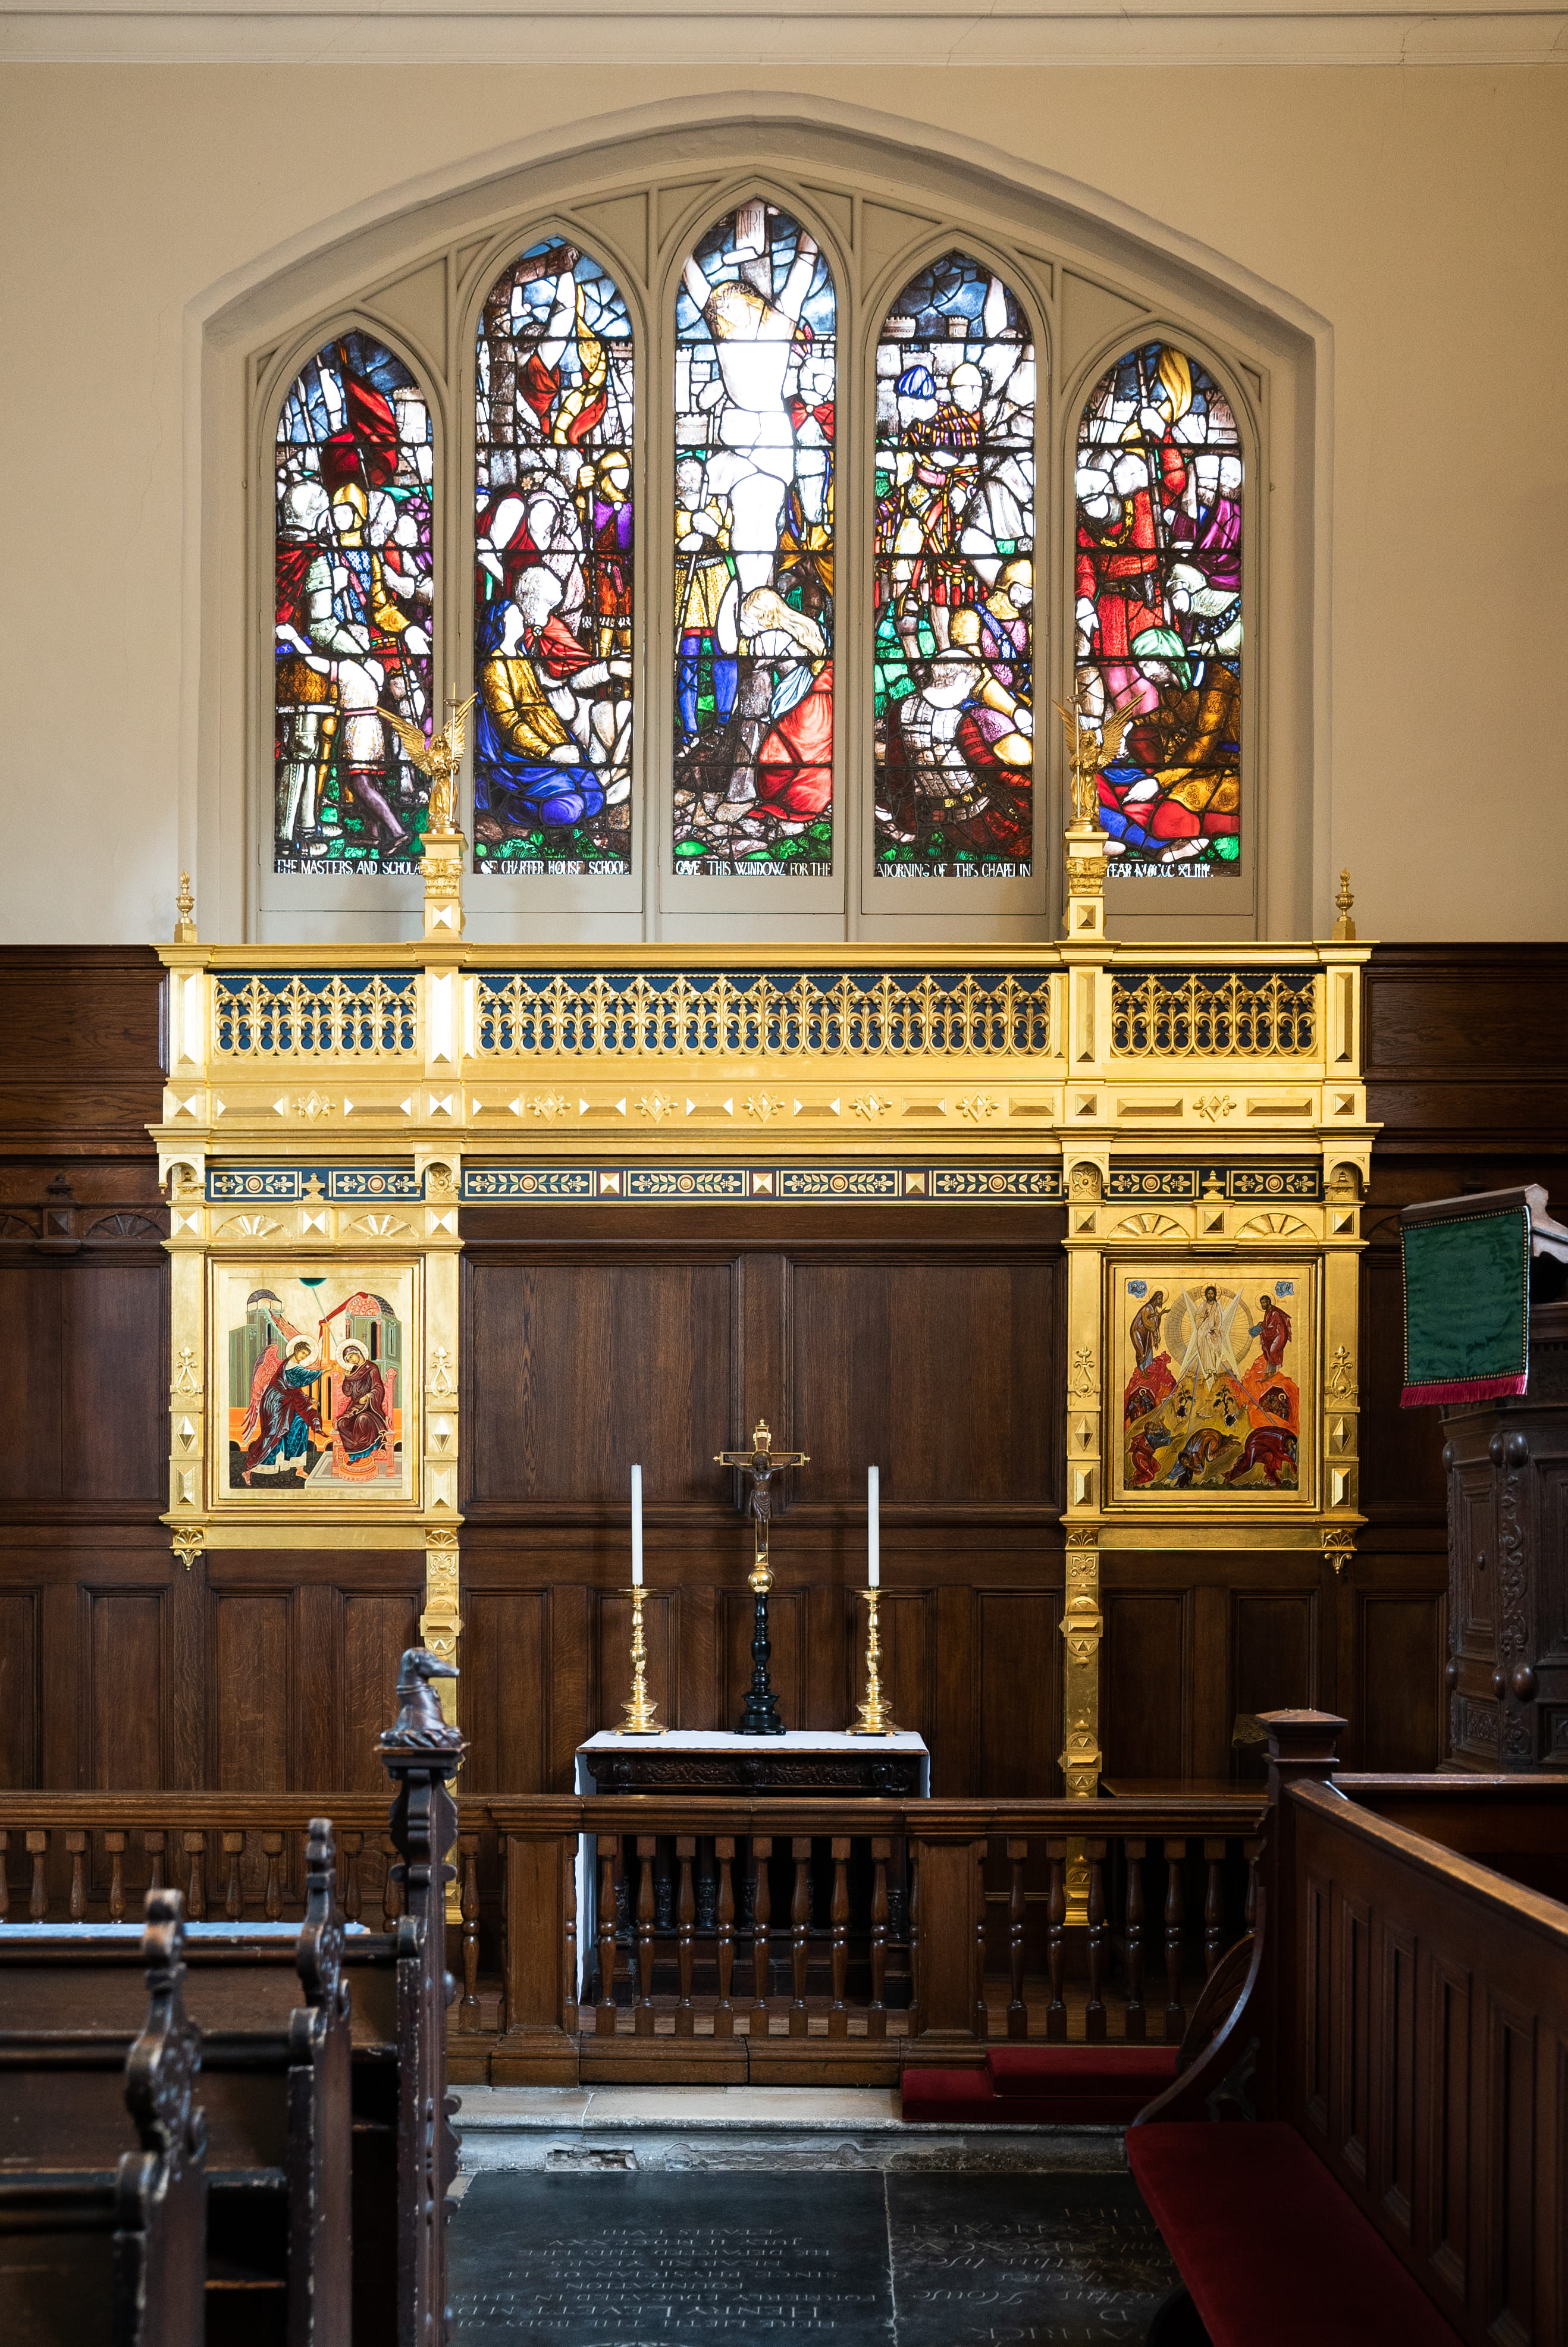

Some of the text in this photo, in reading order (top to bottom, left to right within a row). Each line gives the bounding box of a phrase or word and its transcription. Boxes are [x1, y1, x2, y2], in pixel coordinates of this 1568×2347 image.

[738, 210, 761, 239] INRI
[277, 859, 421, 876] THE MASTERS AND SCHOLA
[501, 860, 544, 874] CHARTER
[548, 860, 584, 874] HOUSE
[588, 860, 629, 874] SCHOOL
[675, 860, 831, 876] GAVE THIS WINDOW FOR THE
[876, 863, 1031, 877] ADORNING OF THIS CHAPEL IN
